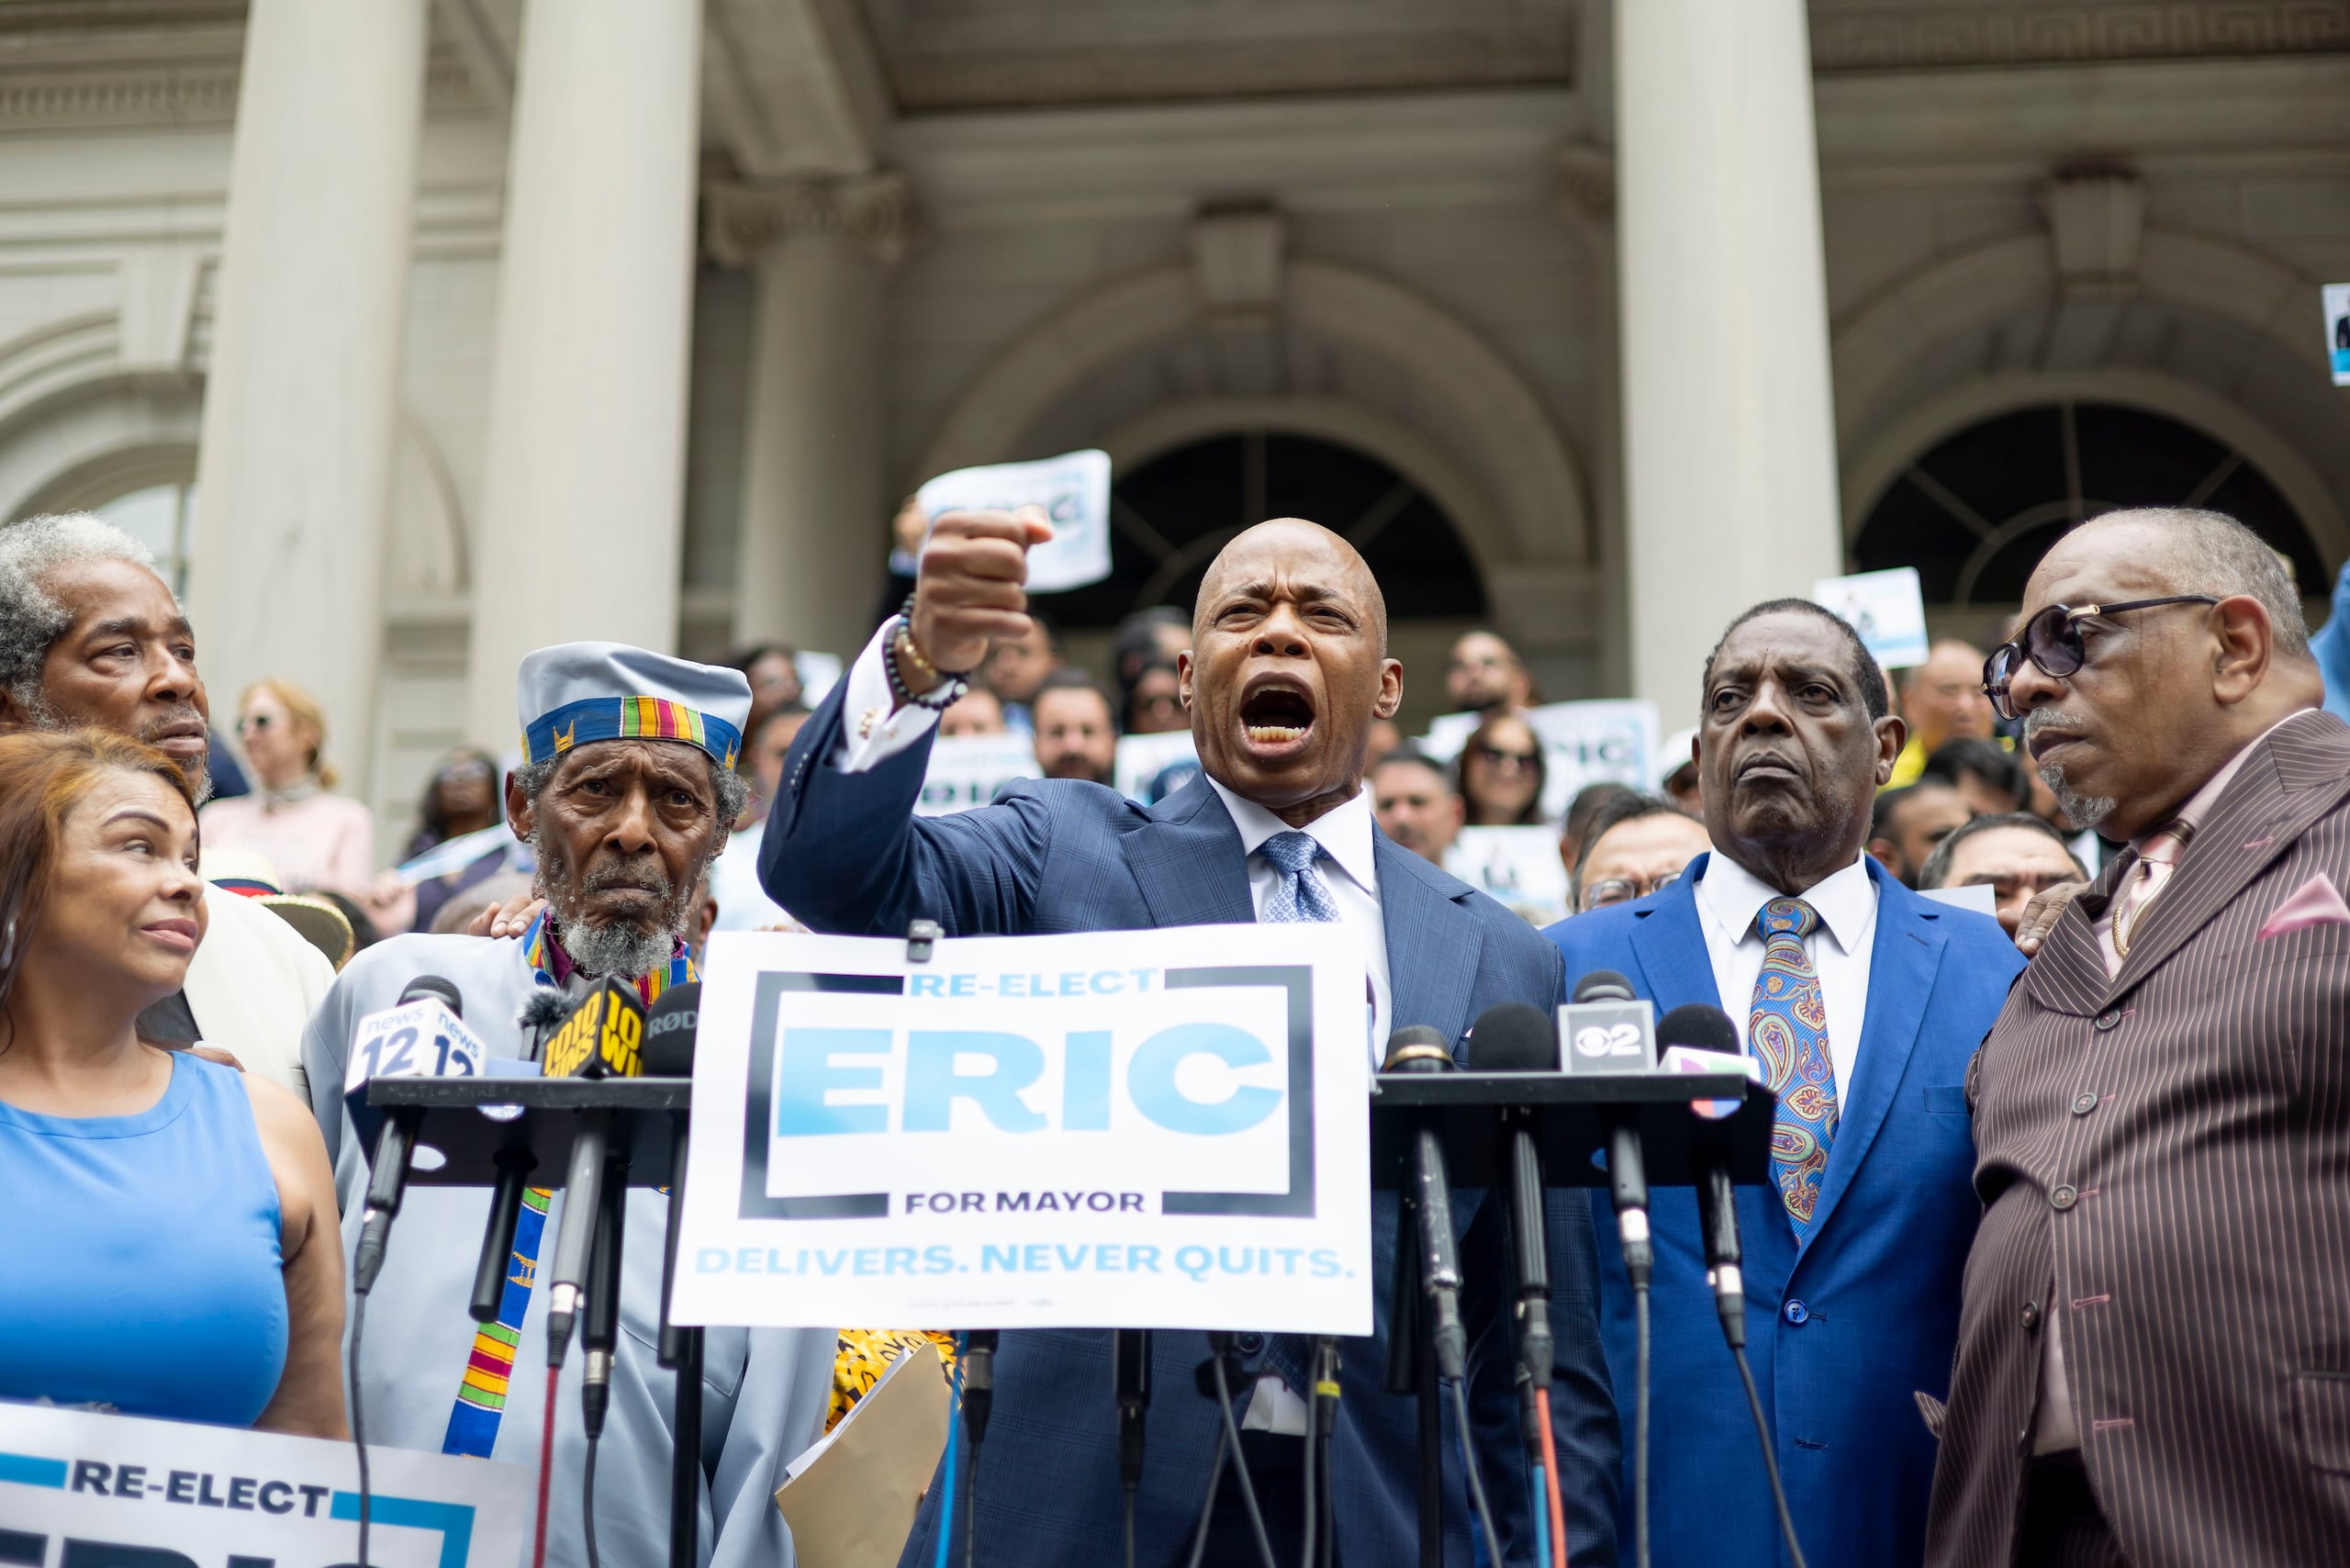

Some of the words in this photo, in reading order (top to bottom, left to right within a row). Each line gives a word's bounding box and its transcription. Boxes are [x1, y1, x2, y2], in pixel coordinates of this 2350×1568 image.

[911, 968, 1158, 998] RE-ELECT
[367, 1008, 424, 1033] news
[439, 1012, 480, 1058] news
[544, 991, 601, 1075] 1010
[608, 990, 642, 1050] 10
[647, 1011, 699, 1039] RØD
[362, 1026, 419, 1077] 12
[601, 1023, 642, 1077] WI
[778, 1022, 1284, 1137] ERIC
[905, 1192, 986, 1215] FOR
[996, 1191, 1145, 1213] MAYOR
[696, 1245, 969, 1276] DELIVERS.
[980, 1244, 1161, 1273] NEVER
[1174, 1244, 1355, 1282] QUITS.
[71, 1460, 330, 1518] RE-ELECT
